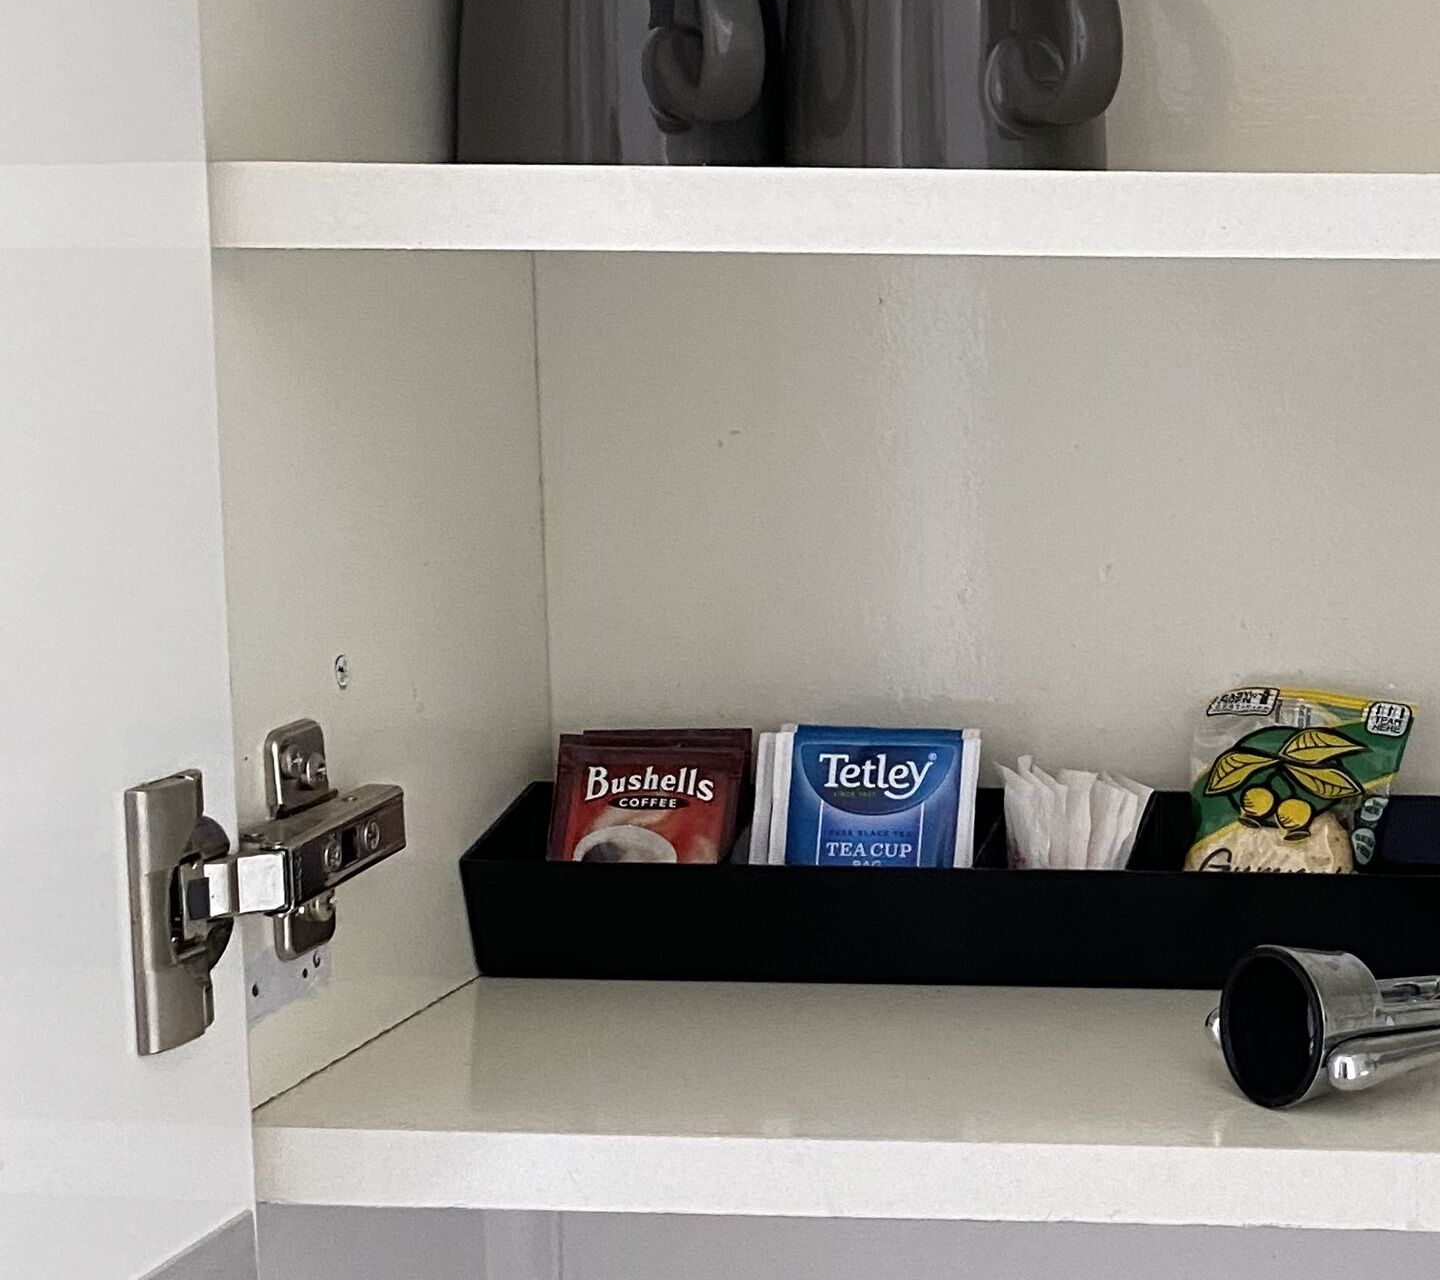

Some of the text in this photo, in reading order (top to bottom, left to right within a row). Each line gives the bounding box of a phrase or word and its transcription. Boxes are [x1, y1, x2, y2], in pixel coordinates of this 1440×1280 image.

[584, 765, 715, 802] Bushells
[618, 798, 678, 809] COFFEE
[826, 841, 912, 858] TEA CUP
